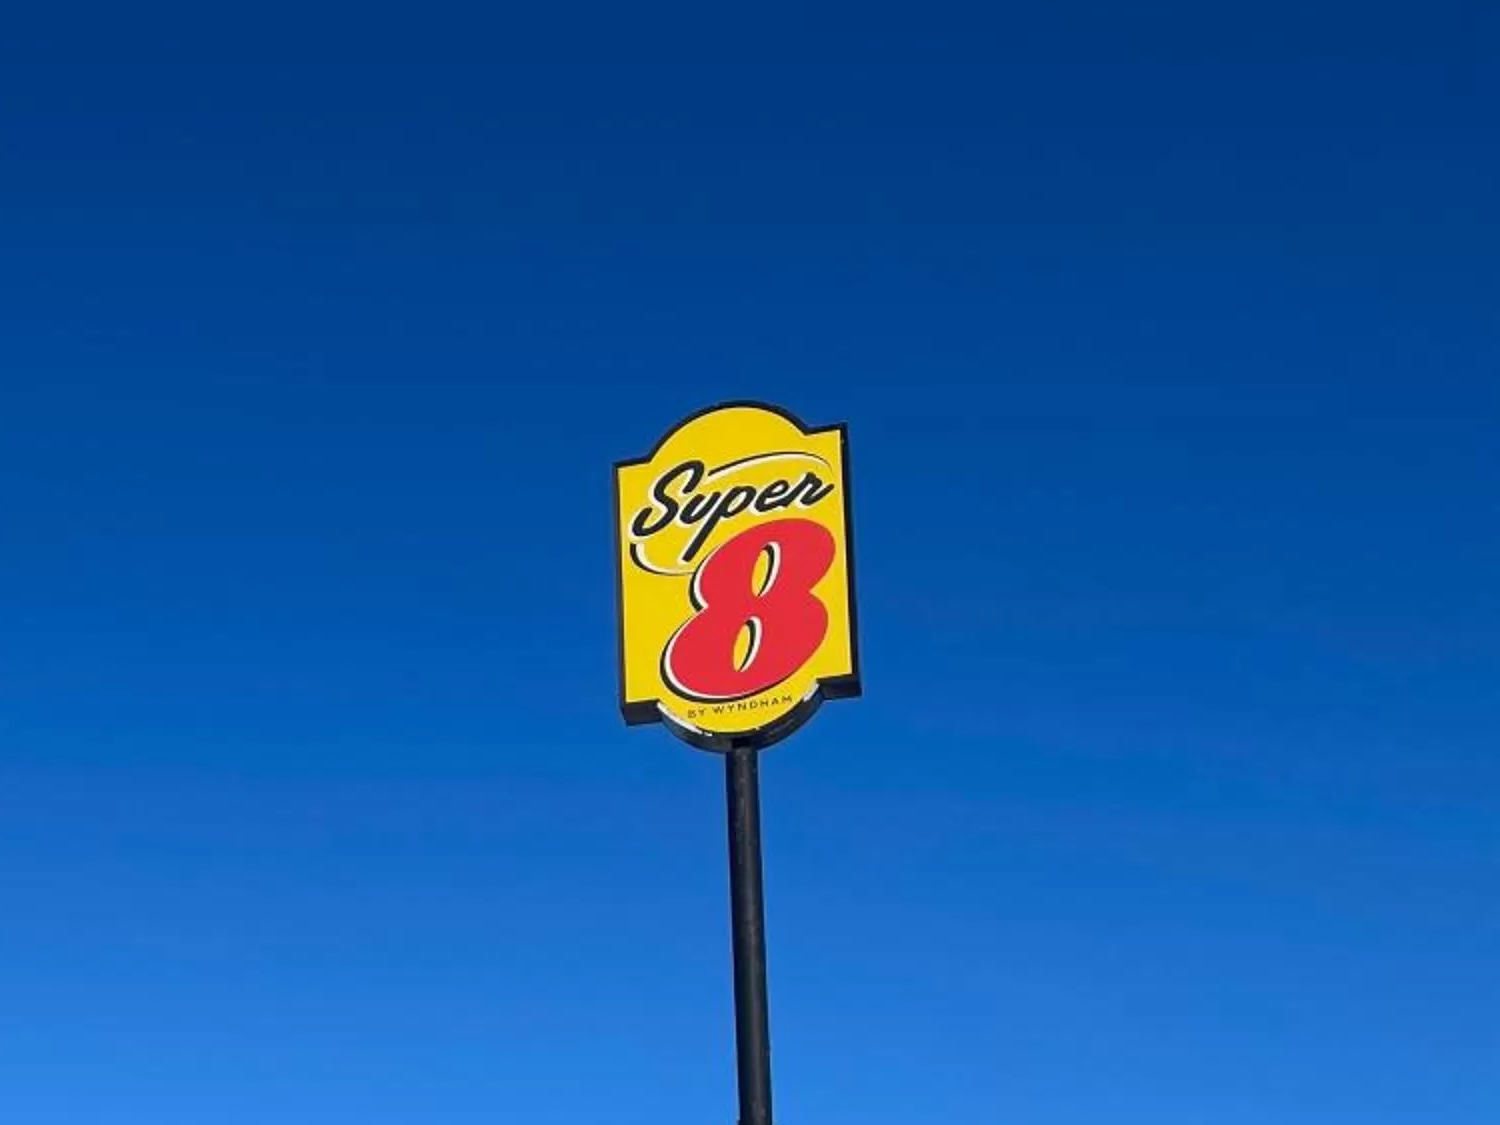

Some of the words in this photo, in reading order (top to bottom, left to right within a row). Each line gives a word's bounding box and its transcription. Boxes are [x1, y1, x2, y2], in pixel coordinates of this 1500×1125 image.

[631, 459, 835, 563] Super
[660, 518, 836, 704] 8
[687, 707, 706, 719] BY
[712, 695, 793, 714] WYNDHAM
